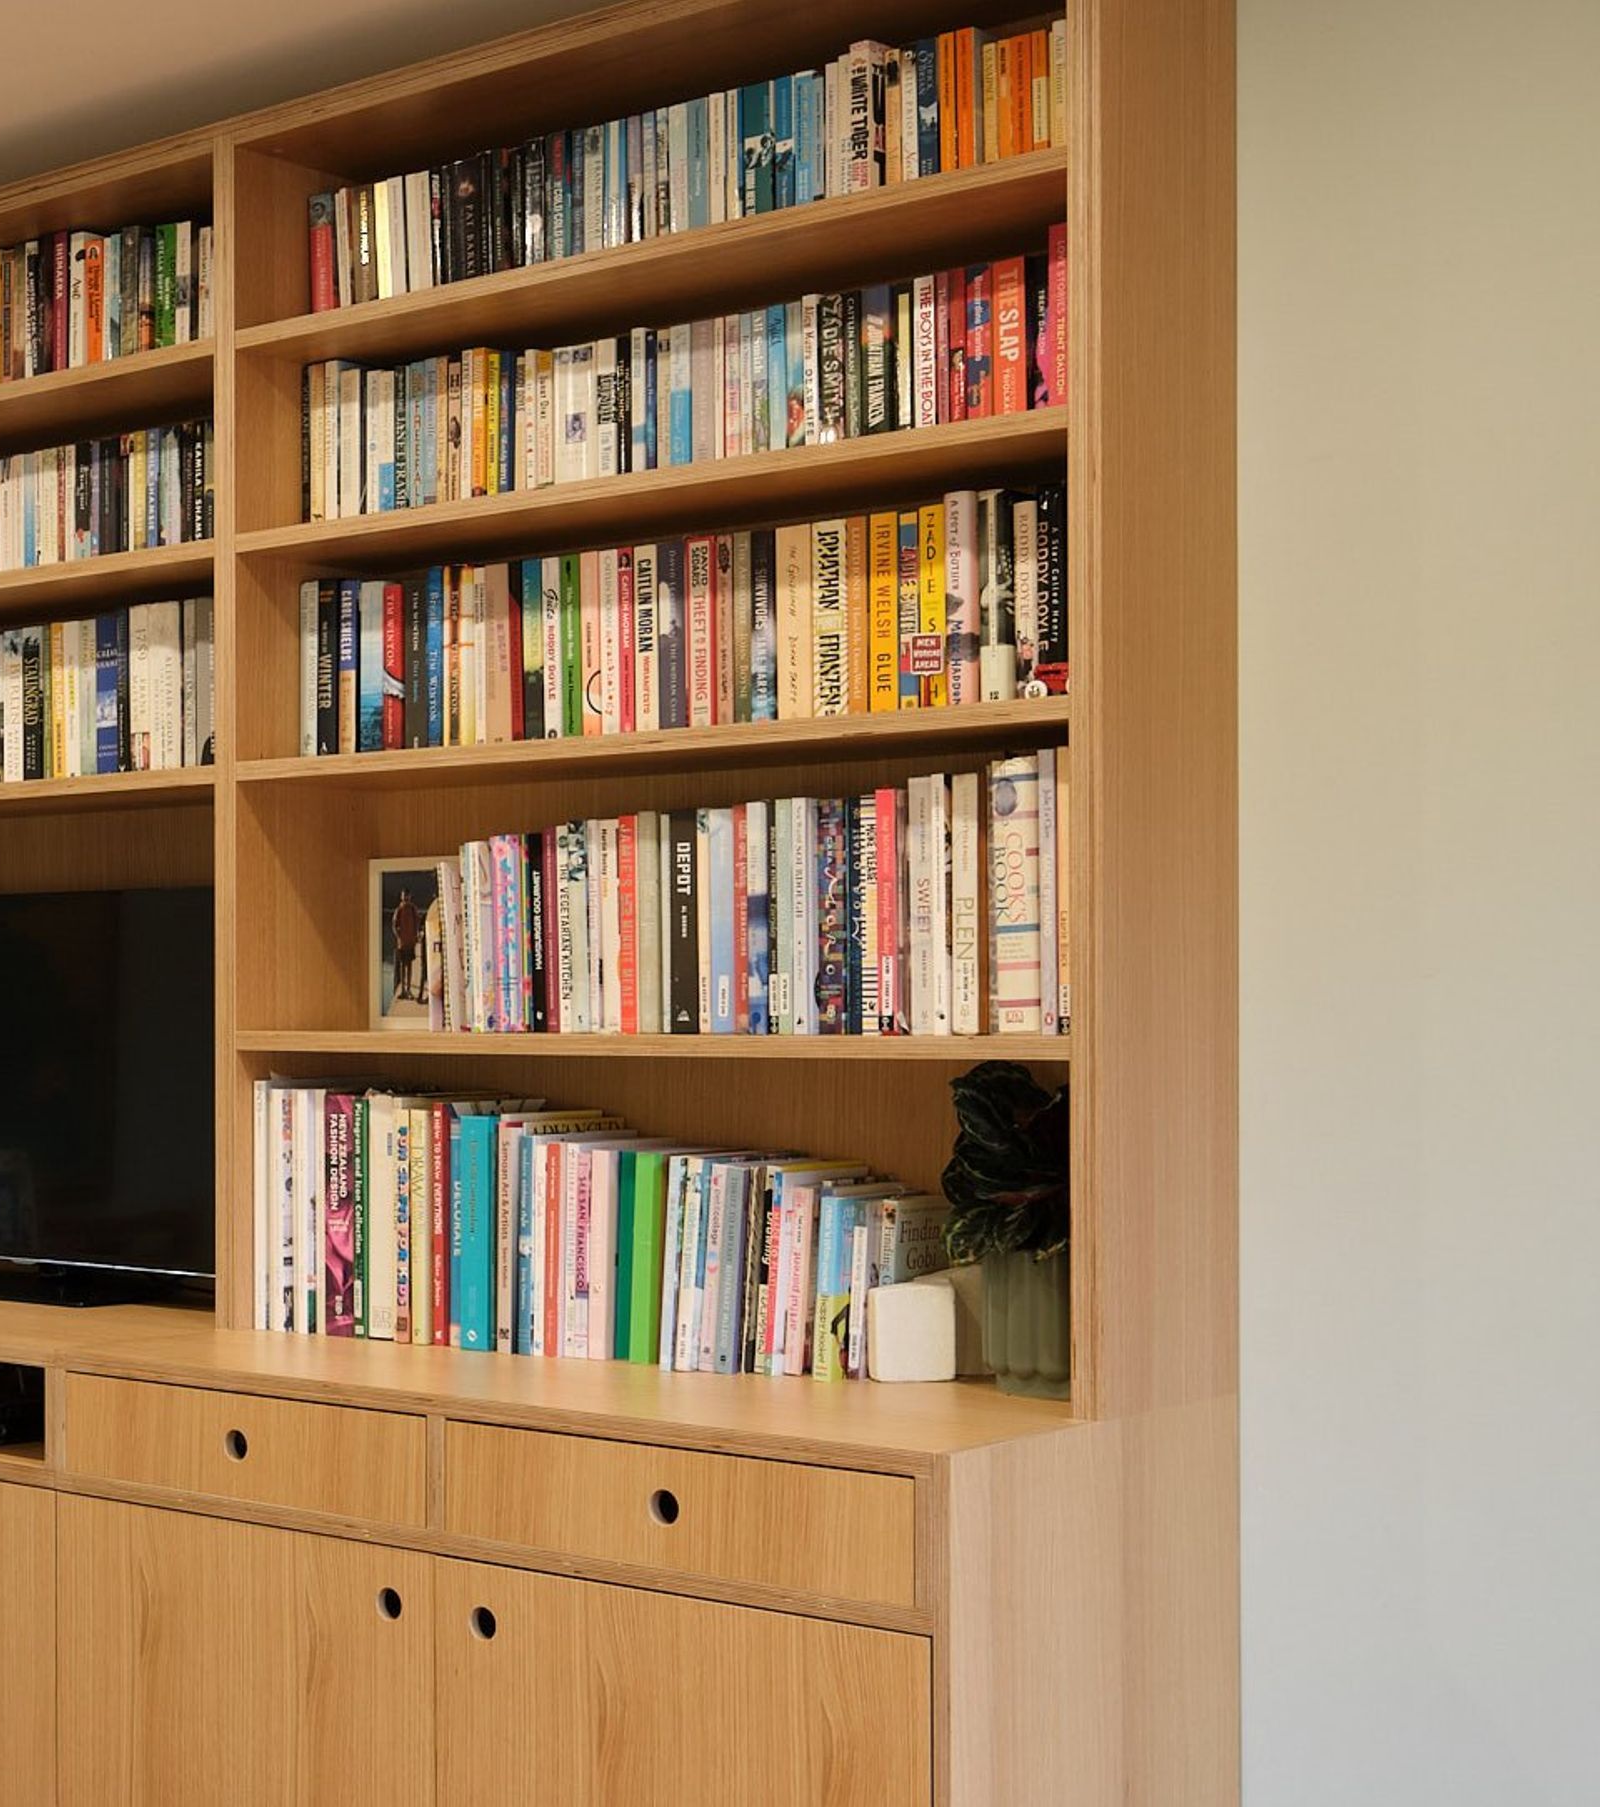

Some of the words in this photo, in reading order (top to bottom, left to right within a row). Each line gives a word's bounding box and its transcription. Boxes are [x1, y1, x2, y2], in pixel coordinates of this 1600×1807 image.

[851, 74, 868, 115] WHITE
[1054, 63, 1065, 105] Bennett
[851, 116, 868, 161] TIGER
[919, 284, 933, 309] THE
[998, 267, 1019, 309] THE
[822, 306, 839, 357] ZADIE
[866, 325, 884, 377] JONATHAN
[919, 311, 933, 347] BOYS
[998, 308, 1019, 362] SLAP
[1056, 317, 1066, 350] TRENT
[753, 336, 763, 374] Smith
[919, 348, 933, 362] IN
[919, 365, 933, 388] THE
[1056, 354, 1066, 396] DALTON
[806, 408, 814, 437] LIFE
[866, 378, 884, 428] FRANZEN
[919, 391, 933, 426] BOAT
[194, 442, 202, 486] KAMILA
[396, 462, 406, 508] FRAME
[194, 499, 202, 540] SHAMS
[1017, 513, 1030, 566] RODDY
[691, 546, 701, 588] SEDARIS
[817, 530, 841, 611] JONATHAN
[876, 524, 892, 578] IRVINE
[926, 513, 937, 595] ZADIE
[1036, 520, 1050, 585] RODDY
[1050, 539, 1061, 562] Star
[622, 575, 630, 610] CAITLIN
[637, 558, 654, 606] CAITLIN
[754, 568, 768, 631] SURVIVORS
[1017, 571, 1030, 621] DOYLE
[1050, 568, 1061, 602] Called
[341, 589, 353, 622] CAROL
[386, 594, 396, 616] TIM
[693, 594, 707, 634] THEFT
[876, 586, 892, 640] WELSH
[1036, 590, 1050, 652] DOYLE
[1050, 610, 1061, 643] Henry
[341, 623, 353, 662] SHIELDS
[386, 620, 396, 668] WINTON
[548, 625, 556, 662] RODDY
[622, 612, 630, 649] MORAN
[637, 608, 654, 654] MORAN
[24, 656, 40, 726] STALINGRAD
[318, 653, 334, 708] WINTER
[548, 664, 556, 701] DOYLE
[693, 648, 707, 702] FINDING
[738, 664, 748, 699] BOYNE
[754, 664, 768, 707] HARPER
[817, 634, 841, 706] FRANZEN
[876, 653, 892, 694] GLUE
[429, 675, 439, 723] WINTON
[675, 841, 691, 895] DEPOT
[994, 846, 1011, 920] BOOK
[1004, 831, 1029, 923] COOK'S
[561, 887, 571, 951] VEGETARIAN
[916, 877, 931, 932] SWEET
[954, 895, 977, 961] PLEN
[561, 954, 571, 1000] KITCHEN
[328, 1113, 339, 1164] FASHION
[338, 1113, 348, 1142] NEW
[354, 1102, 364, 1152] Pictogram
[338, 1144, 348, 1198] ZEALAND
[354, 1157, 364, 1175] and
[501, 1181, 511, 1195] Art
[328, 1168, 339, 1210] DESIGN
[354, 1179, 364, 1200] Icon
[434, 1182, 443, 1235] EVERYTHING
[501, 1198, 511, 1207] &
[576, 1198, 588, 1220] SAN
[354, 1204, 364, 1254] Collection
[501, 1208, 511, 1240] Artists
[899, 1218, 941, 1243] Findin
[576, 1224, 588, 1290] FRANCISCO
[881, 1226, 895, 1272] Finding
